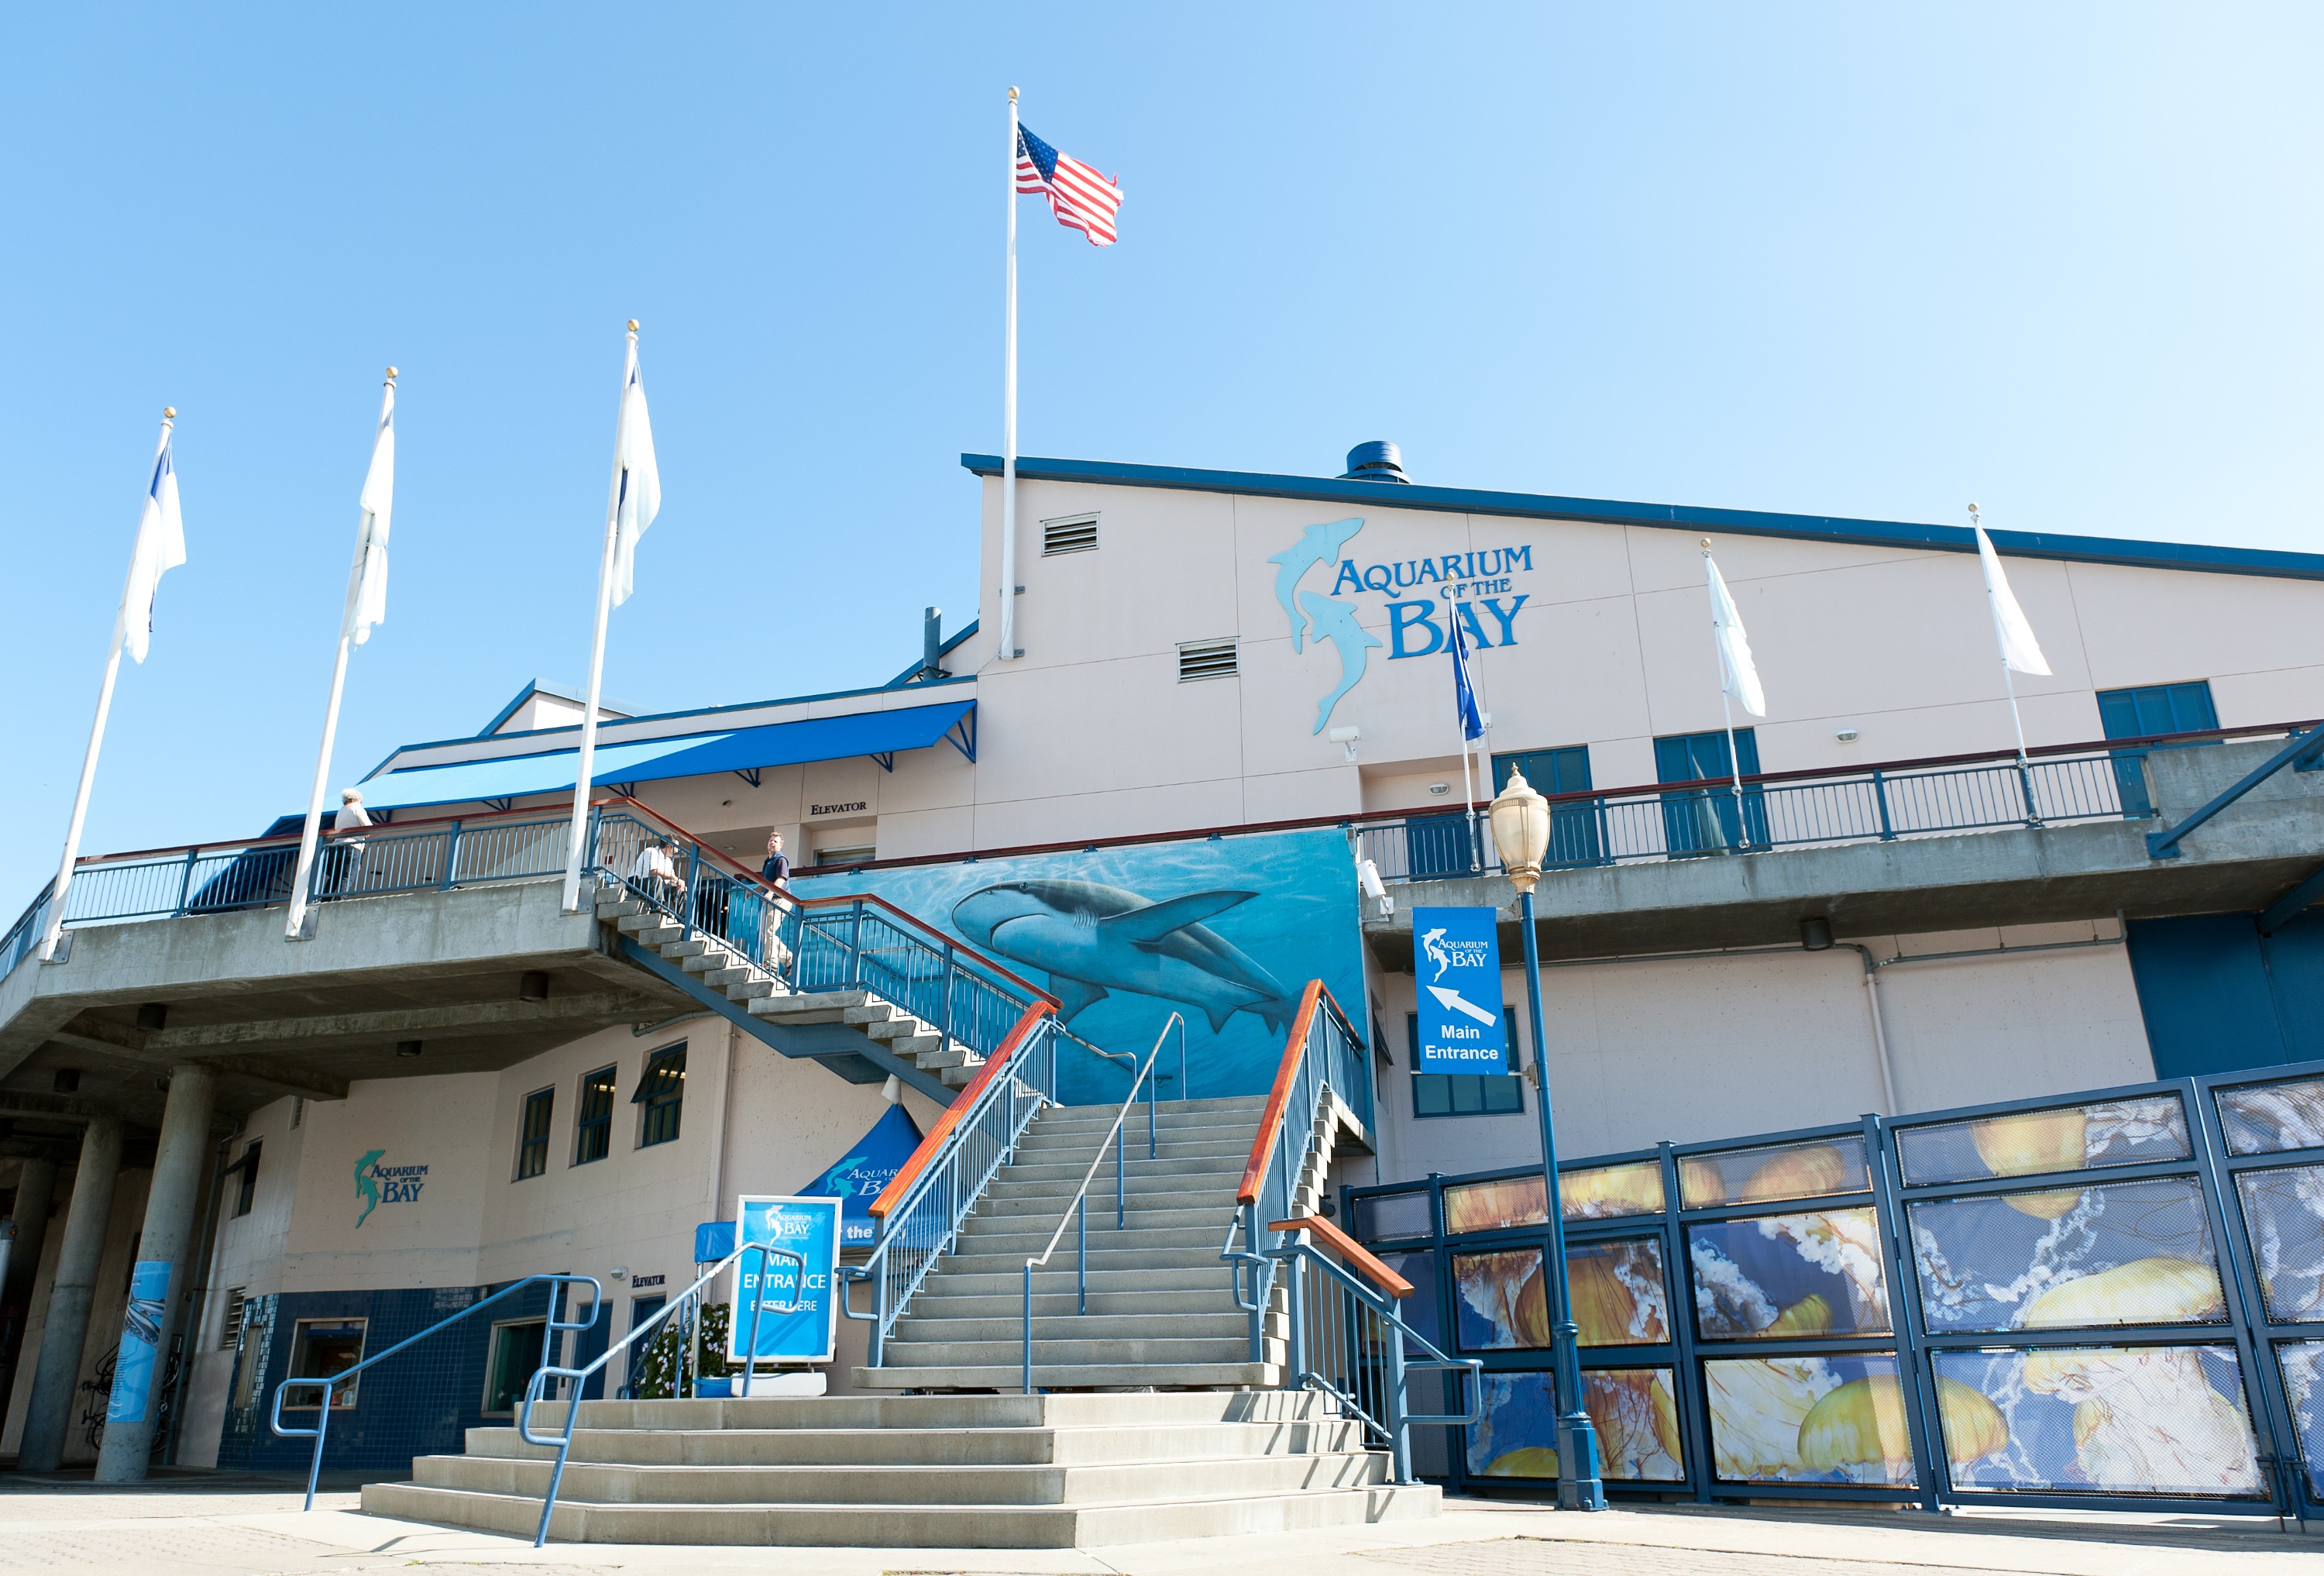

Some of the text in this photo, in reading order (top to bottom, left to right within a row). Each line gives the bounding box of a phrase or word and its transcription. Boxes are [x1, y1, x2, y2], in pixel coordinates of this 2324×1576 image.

[1330, 545, 1534, 598] AQUARIUM
[1440, 578, 1513, 600] OF THE
[1384, 594, 1530, 659] BAY
[810, 801, 867, 815] ELEVATOR
[1438, 938, 1488, 951] AQUARIUM
[1452, 951, 1487, 967] BAY
[1441, 1024, 1480, 1039] Main
[1425, 1044, 1499, 1060] Entrance
[370, 1165, 428, 1181] AQUARIUM
[381, 1182, 425, 1203] BAY
[776, 1213, 812, 1222] AQUARIUM
[784, 1222, 810, 1234] BAY
[847, 1226, 873, 1239] the
[631, 1275, 665, 1288] ELEVATOR
